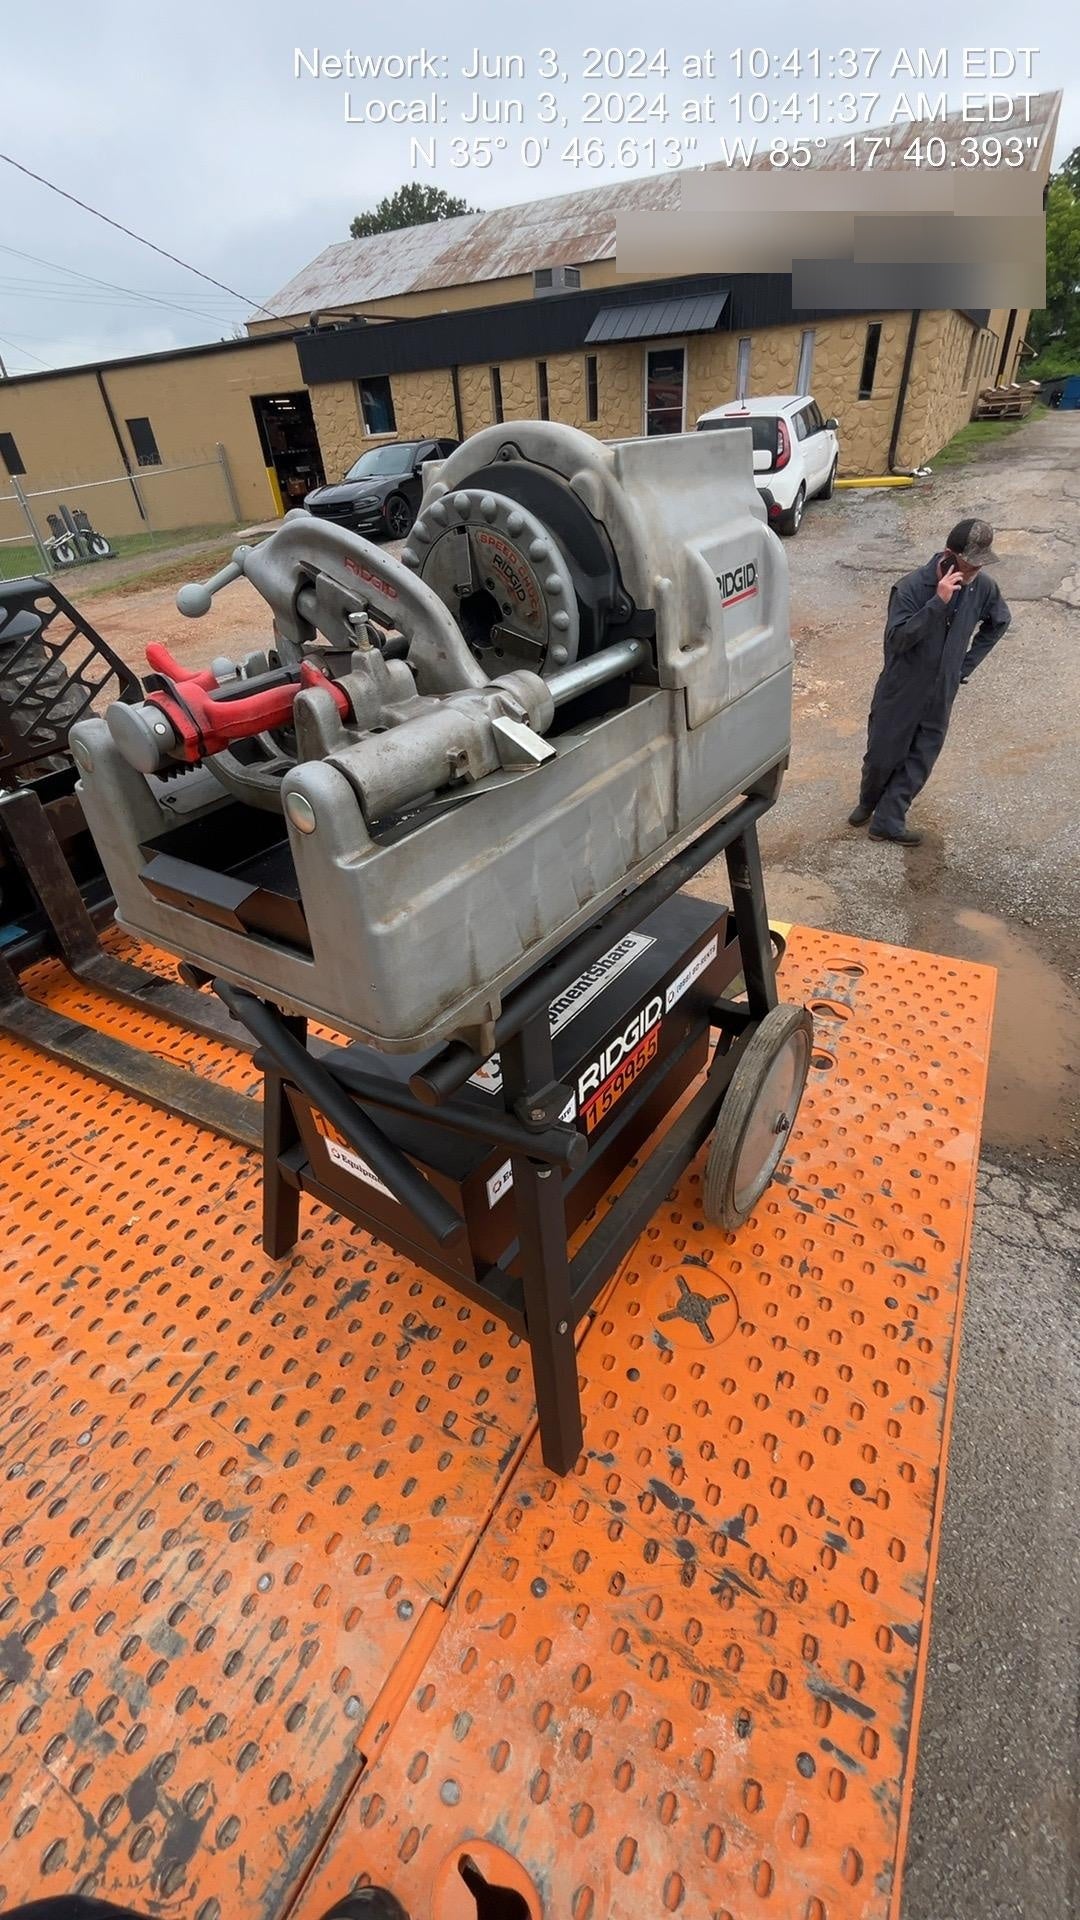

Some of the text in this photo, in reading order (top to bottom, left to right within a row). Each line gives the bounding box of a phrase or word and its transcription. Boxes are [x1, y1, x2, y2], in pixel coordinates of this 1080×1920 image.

[478, 533, 518, 565] SPEED
[343, 555, 399, 600] RIDGID
[493, 553, 527, 602] RIDGID
[578, 996, 663, 1106] RIDGID
[587, 1033, 659, 1127] 159955
